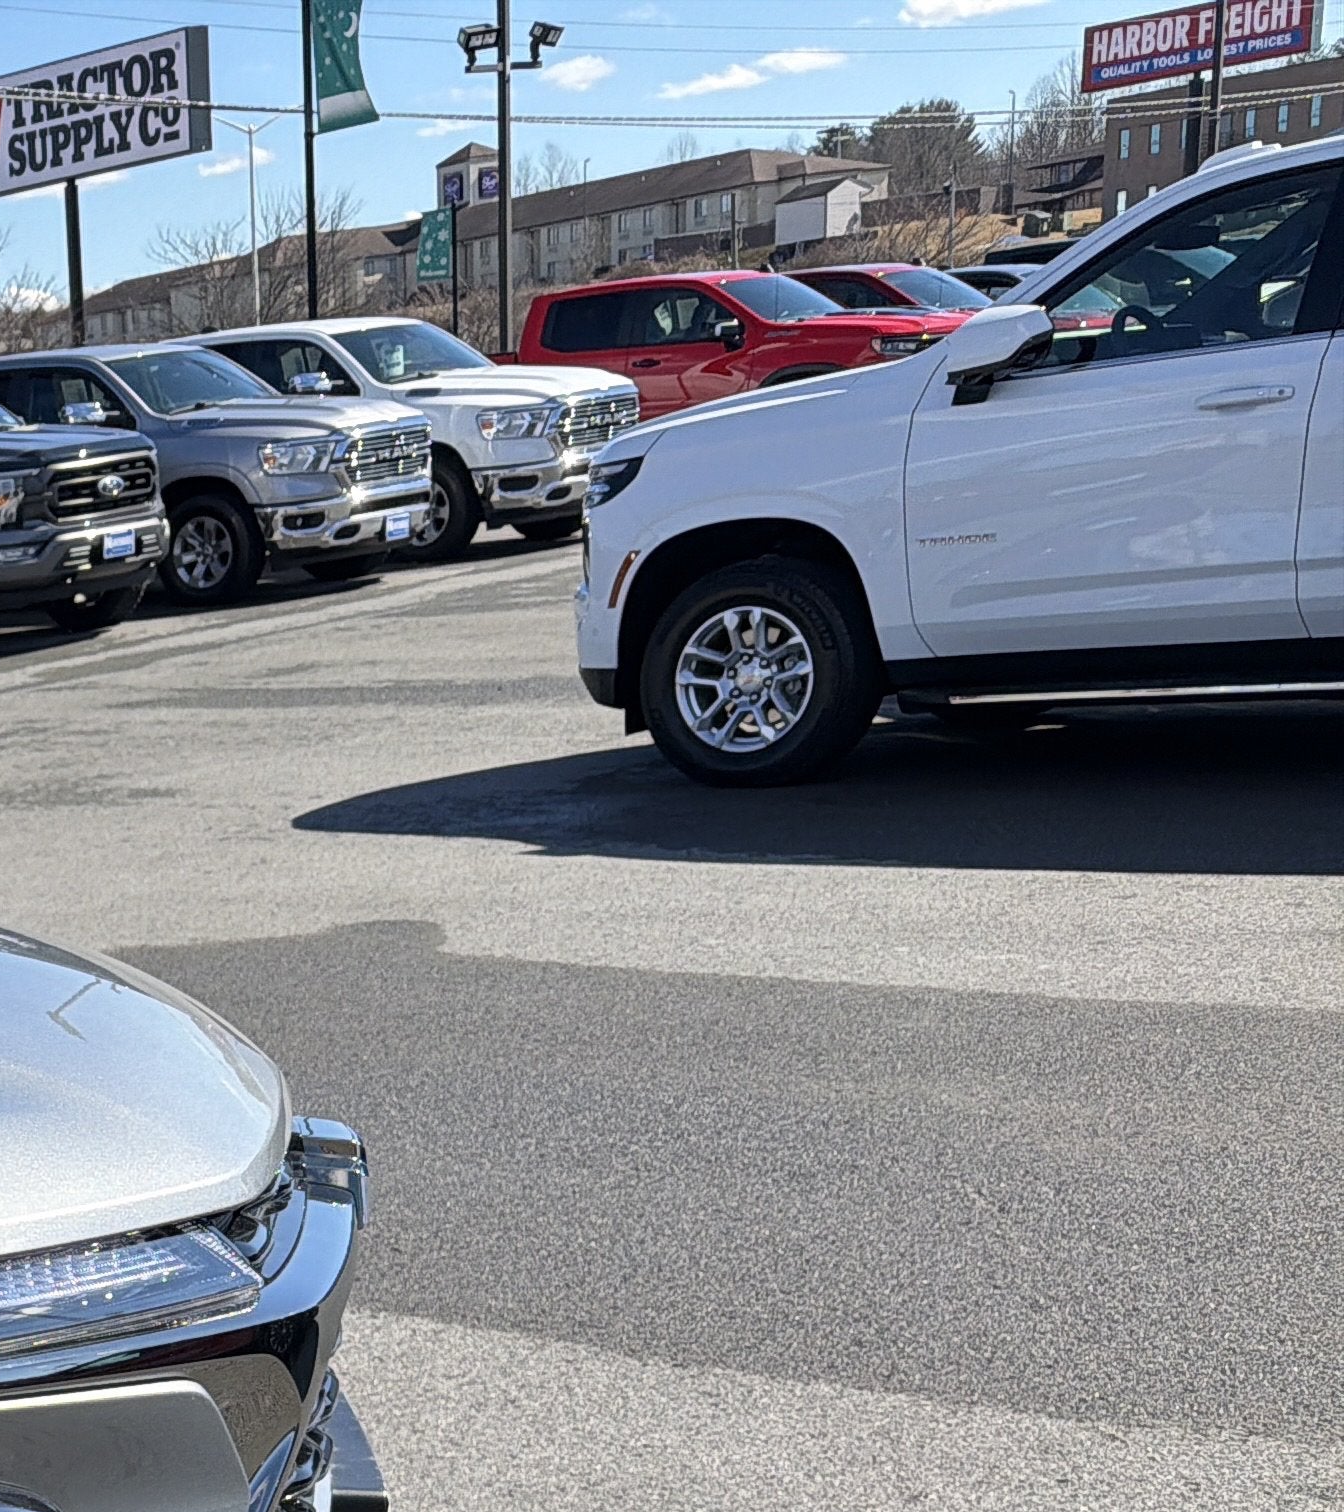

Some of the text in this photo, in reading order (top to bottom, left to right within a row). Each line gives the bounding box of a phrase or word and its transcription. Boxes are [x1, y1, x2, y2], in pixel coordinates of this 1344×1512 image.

[1092, 15, 1191, 64] HARBOR
[1100, 32, 1292, 79] QUALITY TOOLS LOEST PRICES
[6, 47, 179, 128] TRACTOR
[8, 106, 134, 177] SUPPLY
